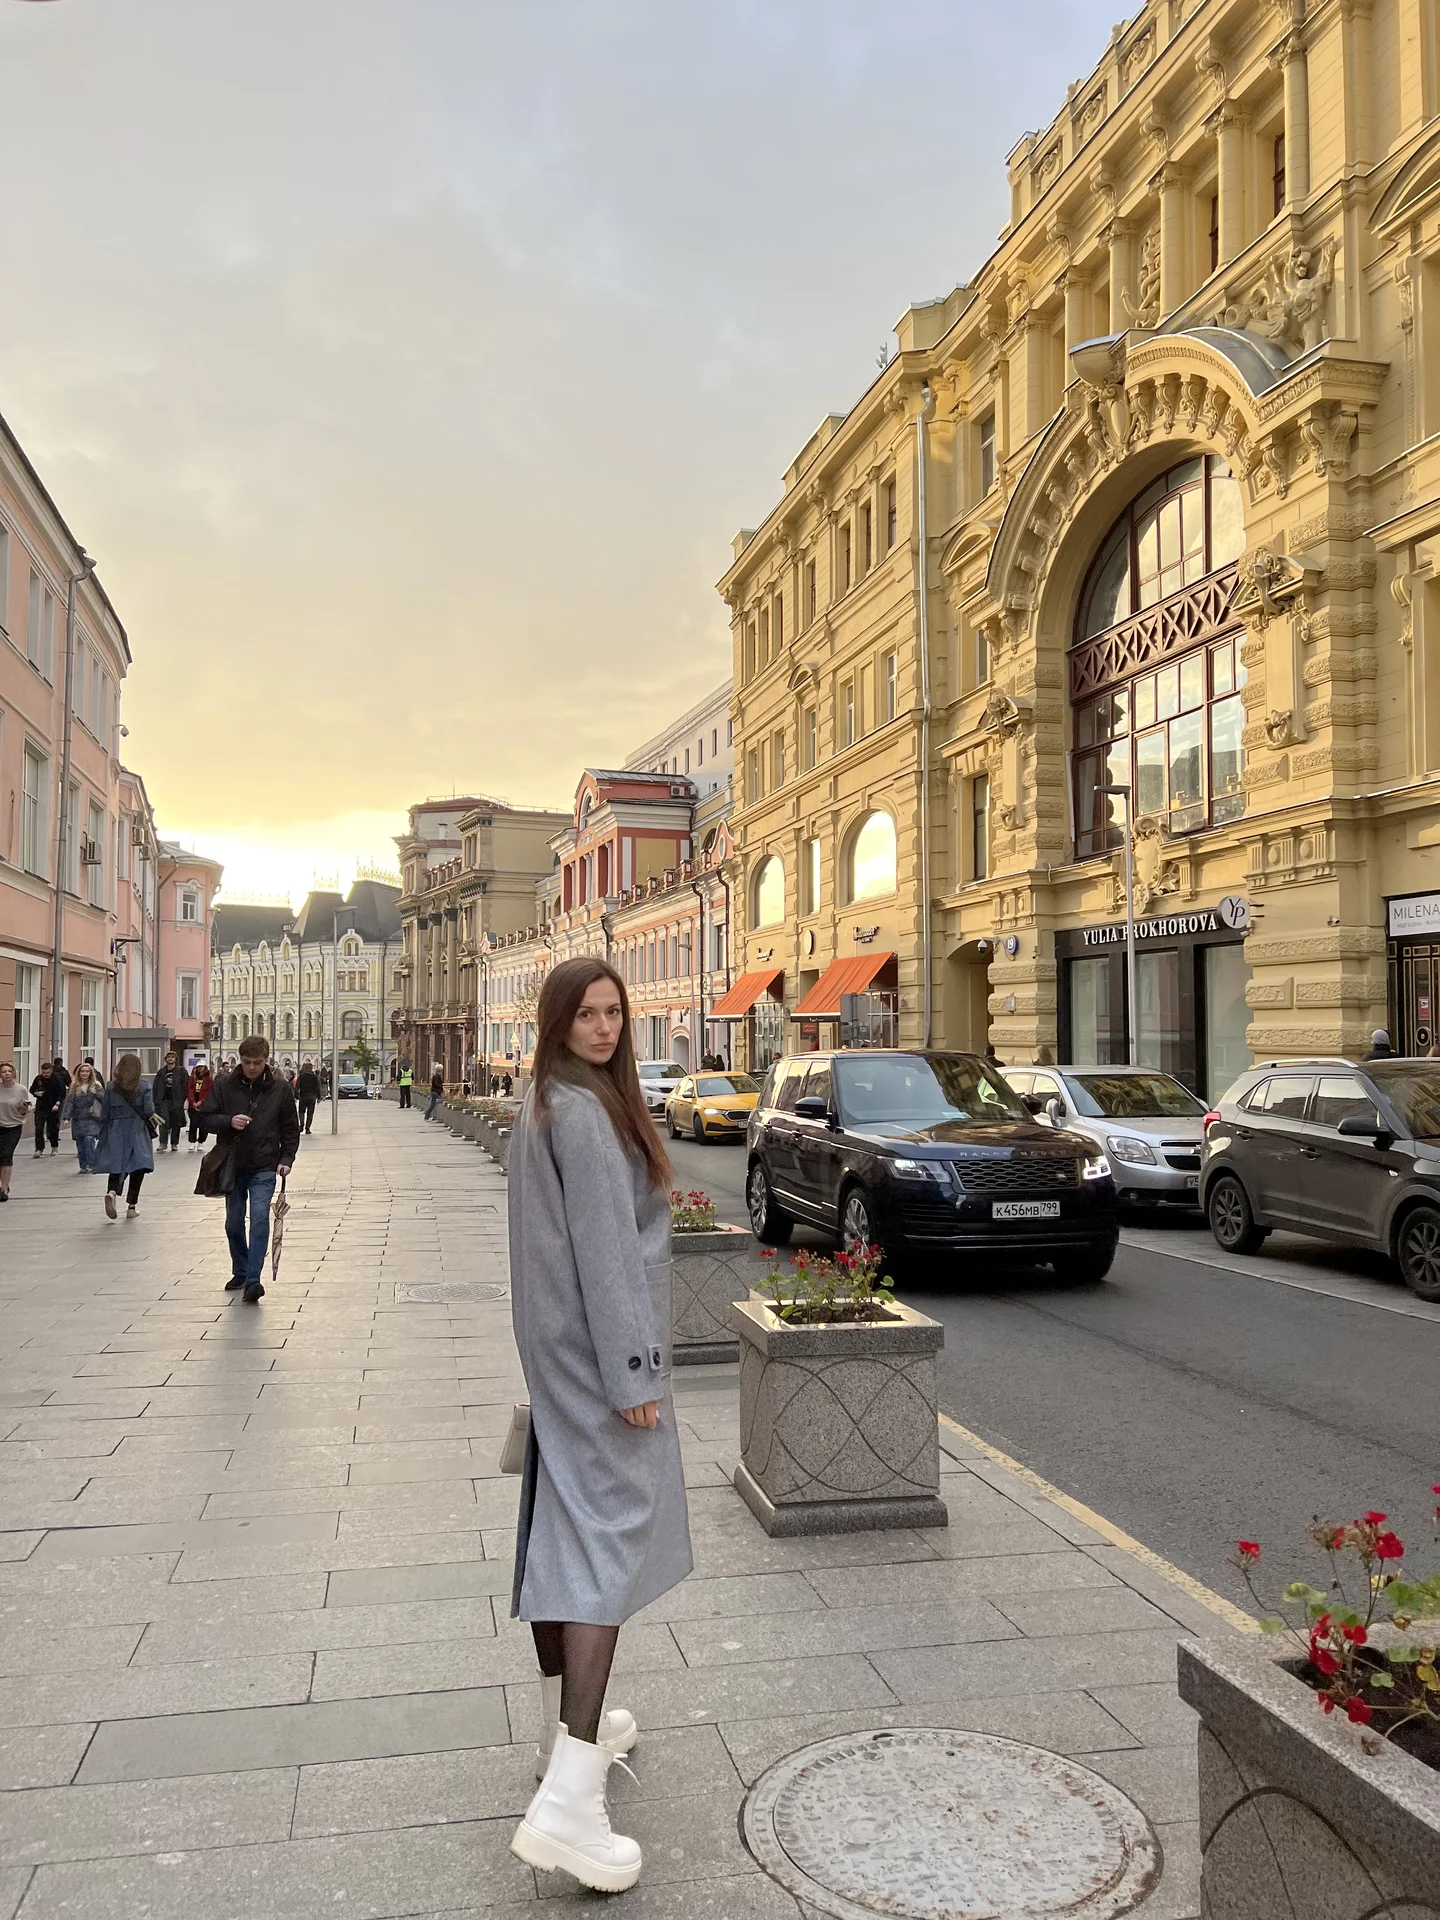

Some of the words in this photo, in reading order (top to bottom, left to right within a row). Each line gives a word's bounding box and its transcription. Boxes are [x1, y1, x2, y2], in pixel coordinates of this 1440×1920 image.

[1393, 903, 1440, 920] MILENA
[1083, 926, 1118, 946] YULIA
[1007, 938, 1014, 950] 19
[1041, 1202, 1058, 1212] 799
